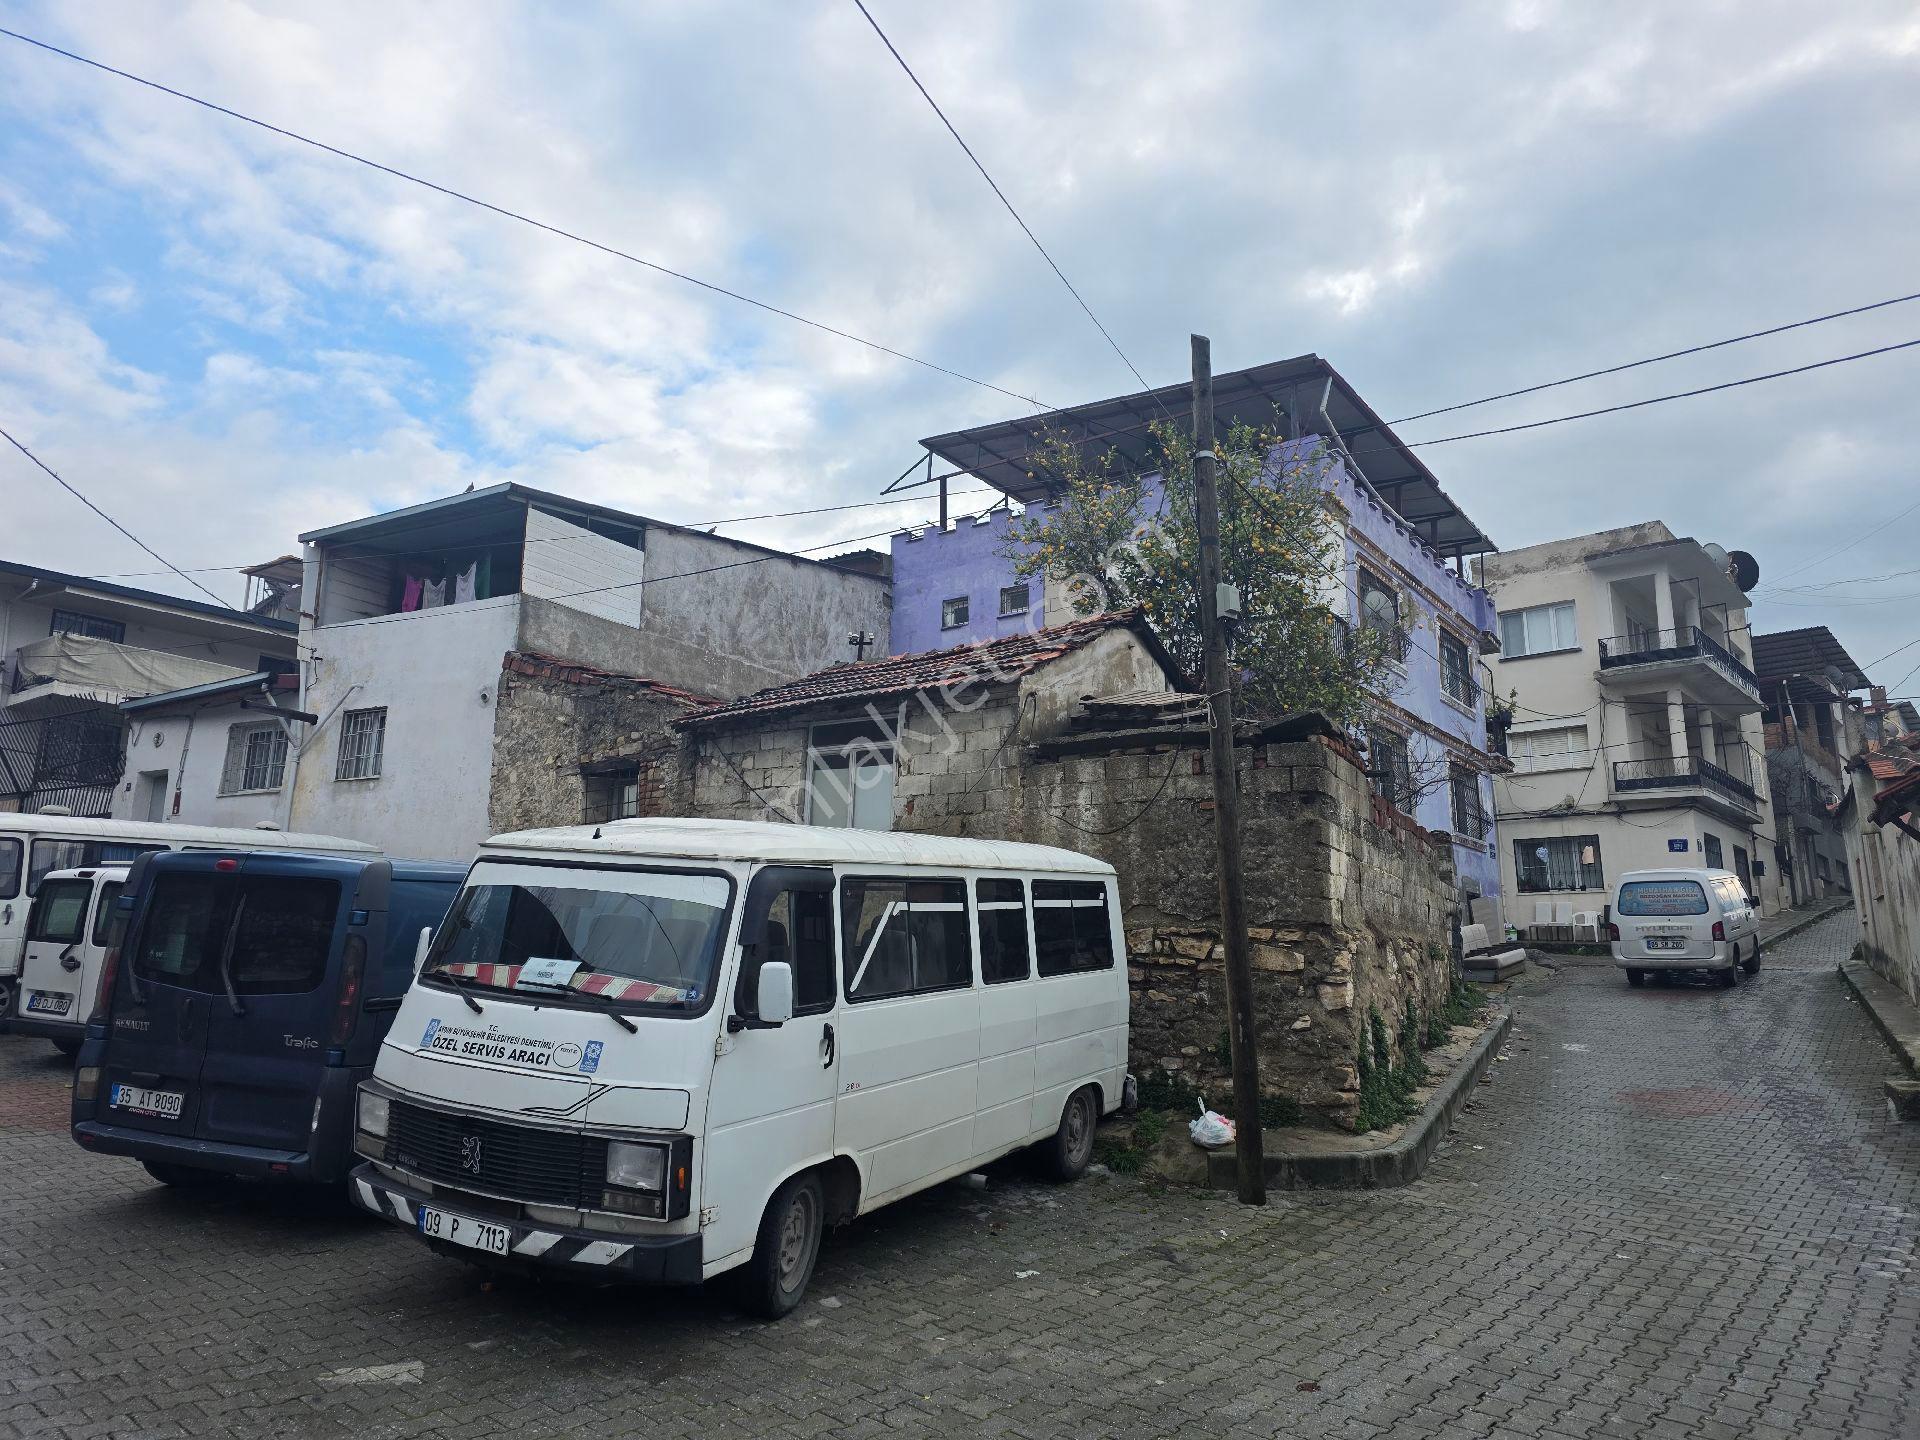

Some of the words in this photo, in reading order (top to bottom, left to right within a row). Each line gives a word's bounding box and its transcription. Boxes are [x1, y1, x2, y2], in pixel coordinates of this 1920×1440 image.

[115, 1018, 150, 1031] RENAULT
[283, 1034, 319, 1049] Trafic
[432, 1036, 458, 1051] ÖZEL
[461, 1041, 506, 1059] SERVİS
[507, 1048, 551, 1066] ARACI
[119, 1087, 132, 1104] 35
[139, 1091, 153, 1107] AT
[154, 1093, 180, 1112] 8090
[425, 1211, 441, 1234] 09
[450, 1218, 459, 1239] P
[475, 1223, 506, 1252] 7113
